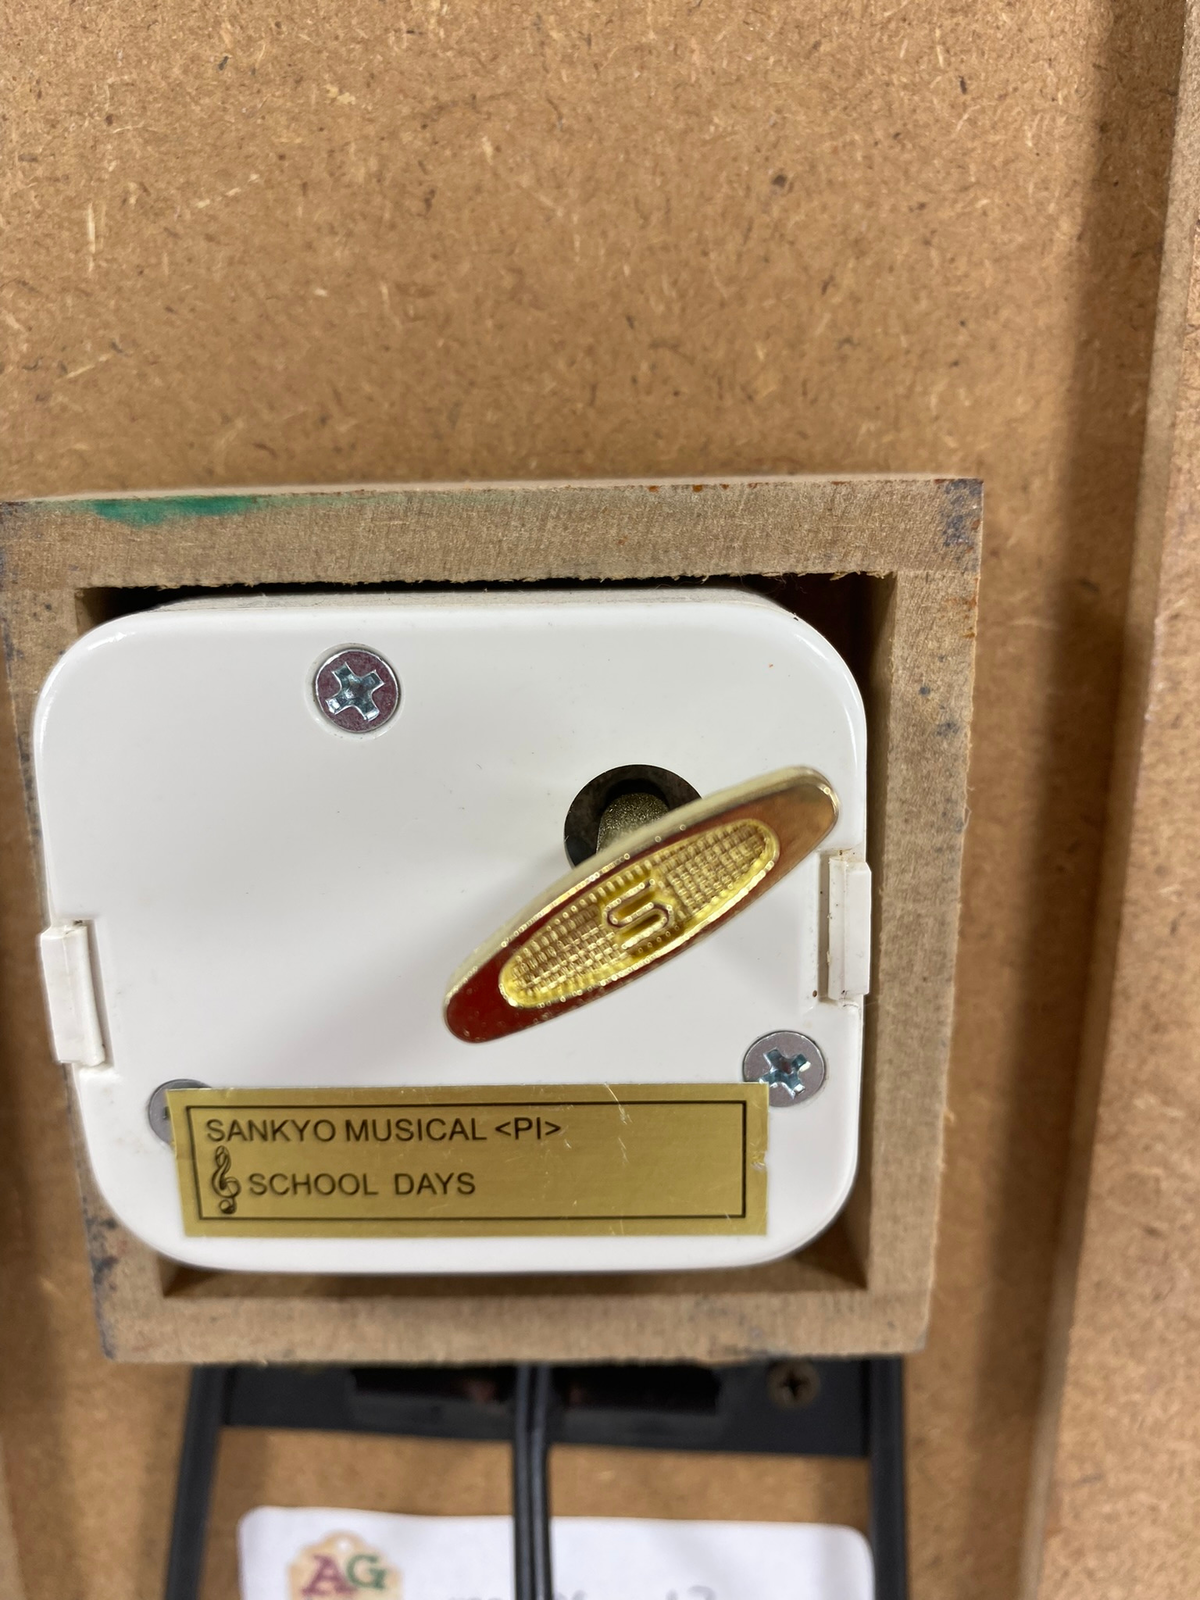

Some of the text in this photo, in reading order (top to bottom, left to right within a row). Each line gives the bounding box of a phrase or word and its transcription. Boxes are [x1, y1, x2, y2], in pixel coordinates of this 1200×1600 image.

[206, 1117, 562, 1142] SANKYO MUSICAL <PI>
[249, 1172, 476, 1196] SCHOOL DAYS
[301, 1553, 388, 1596] AG
